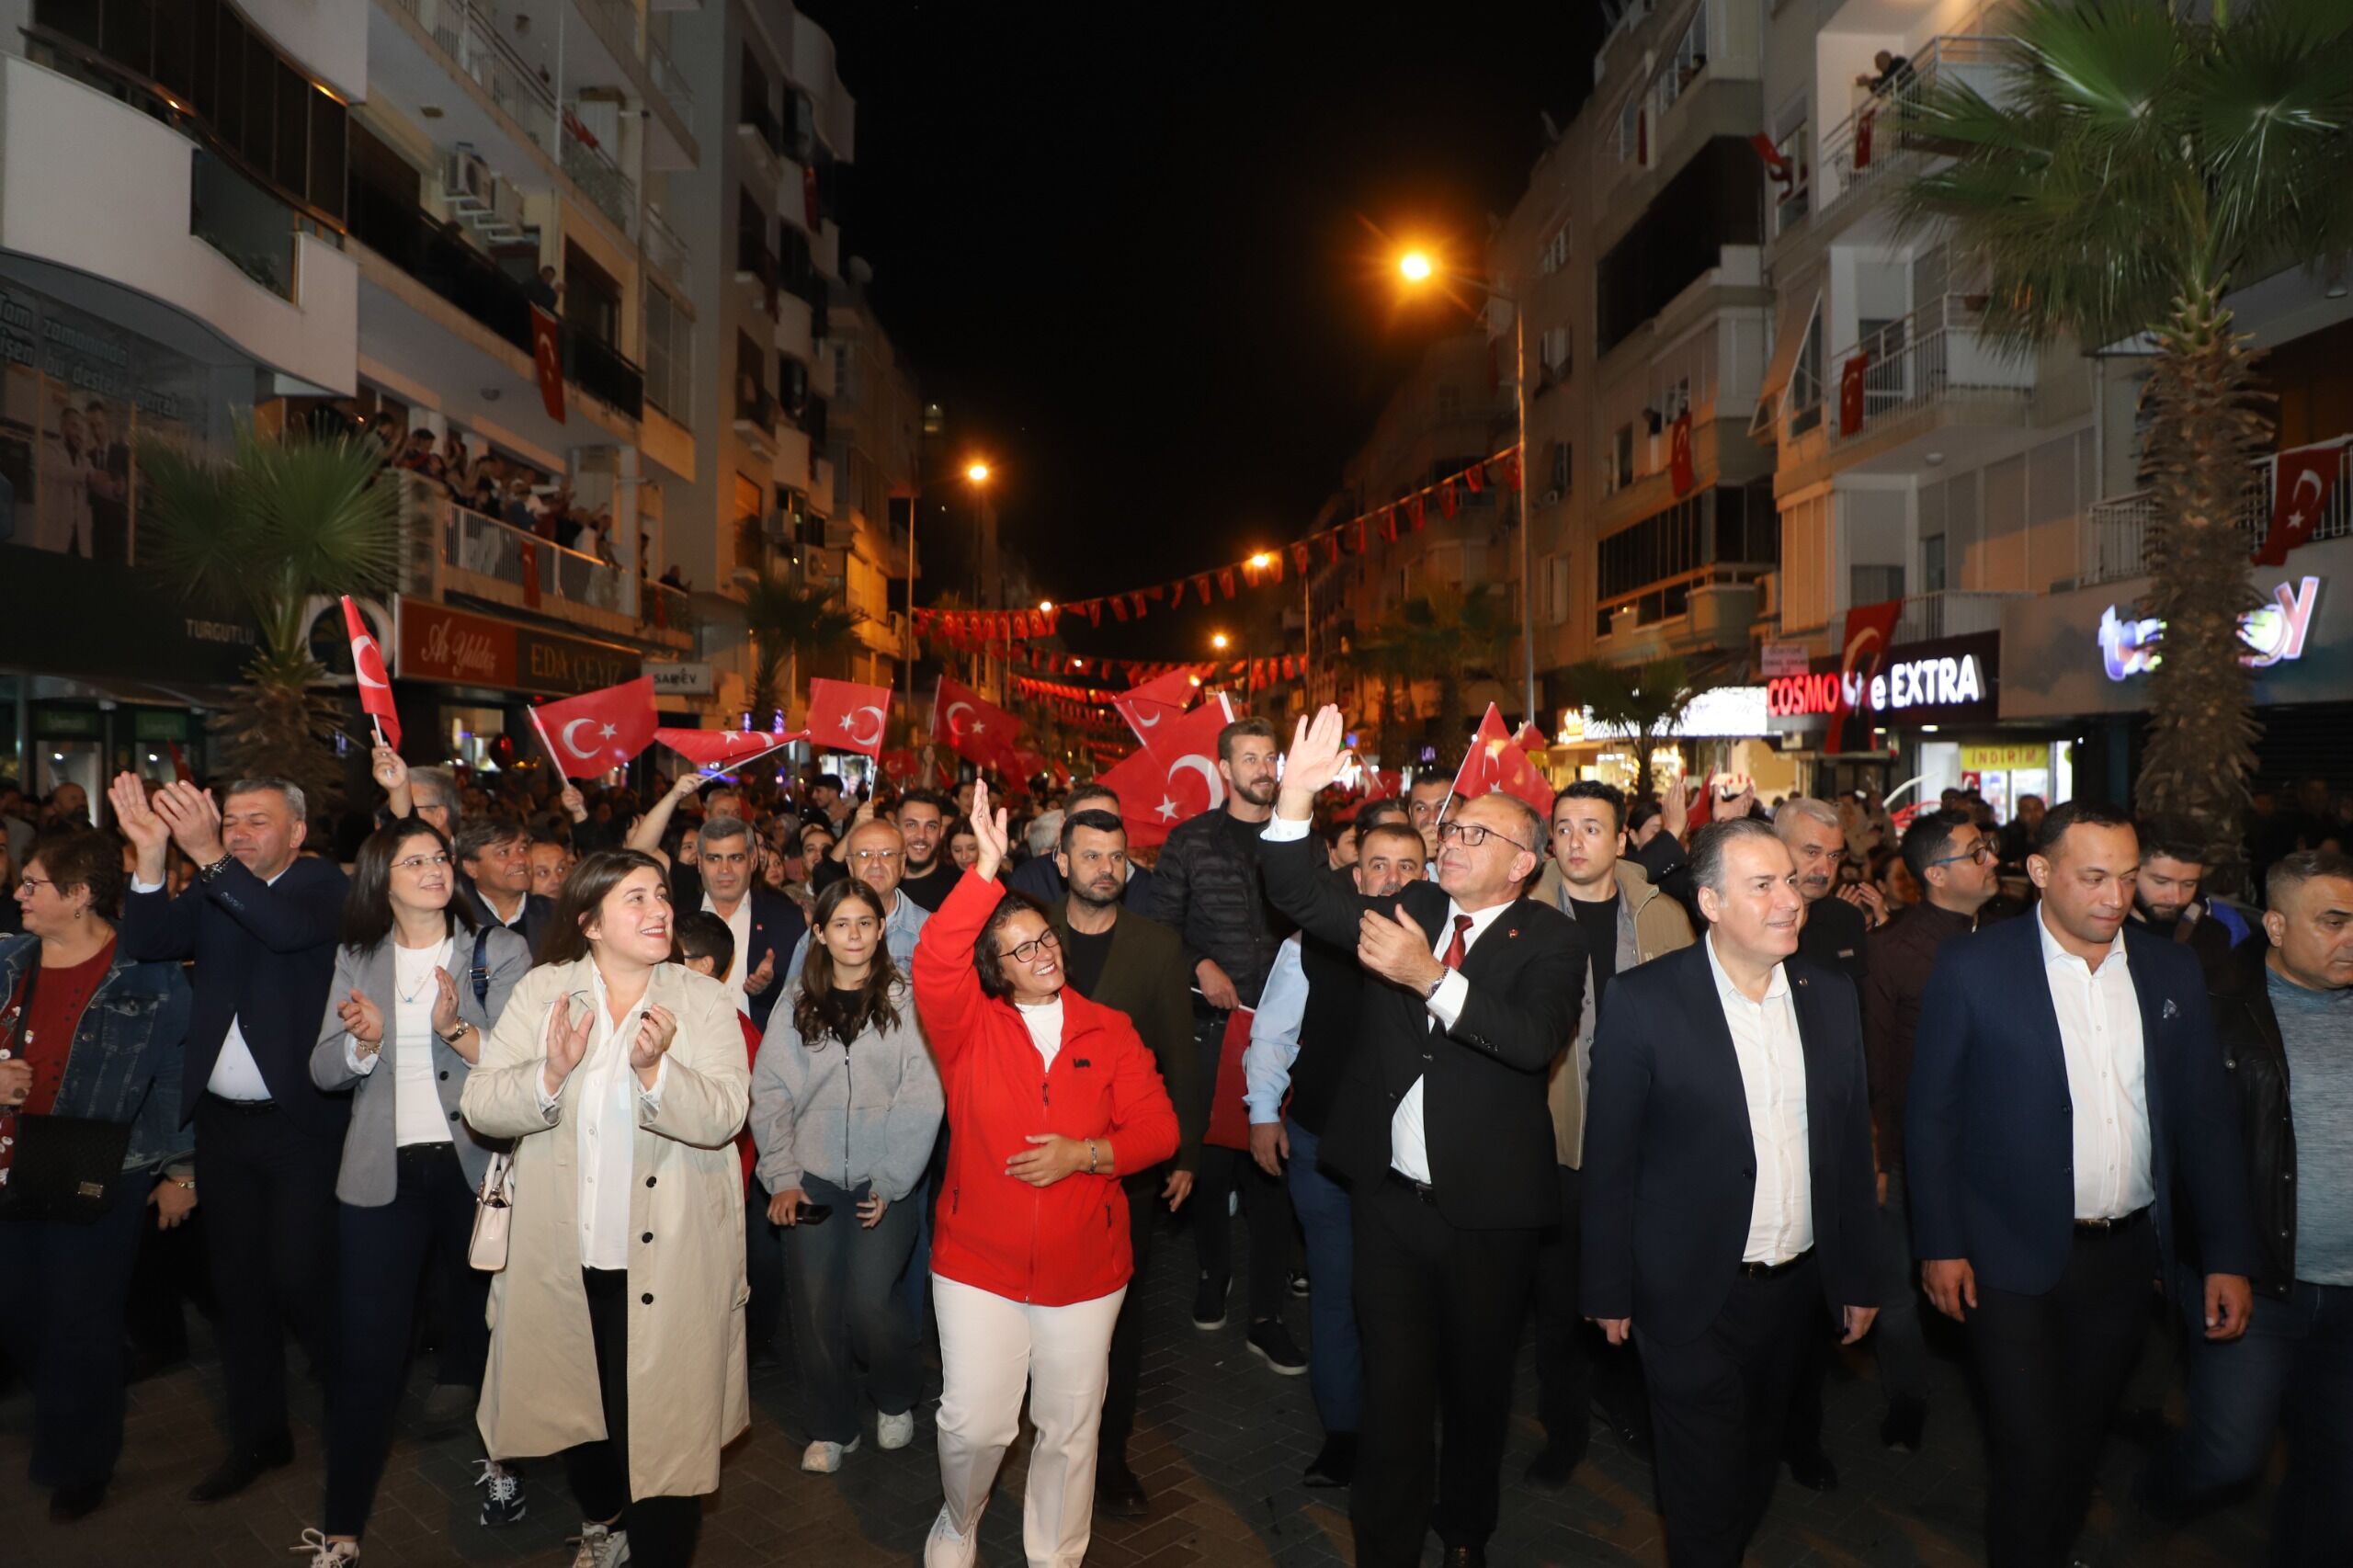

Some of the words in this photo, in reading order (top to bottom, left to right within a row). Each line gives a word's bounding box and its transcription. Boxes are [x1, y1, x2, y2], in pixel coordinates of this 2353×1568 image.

[184, 617, 256, 646] TURGUTLU
[530, 642, 571, 681] EDA
[1767, 673, 1840, 717] COSMO
[1891, 653, 1979, 709] EXTRA
